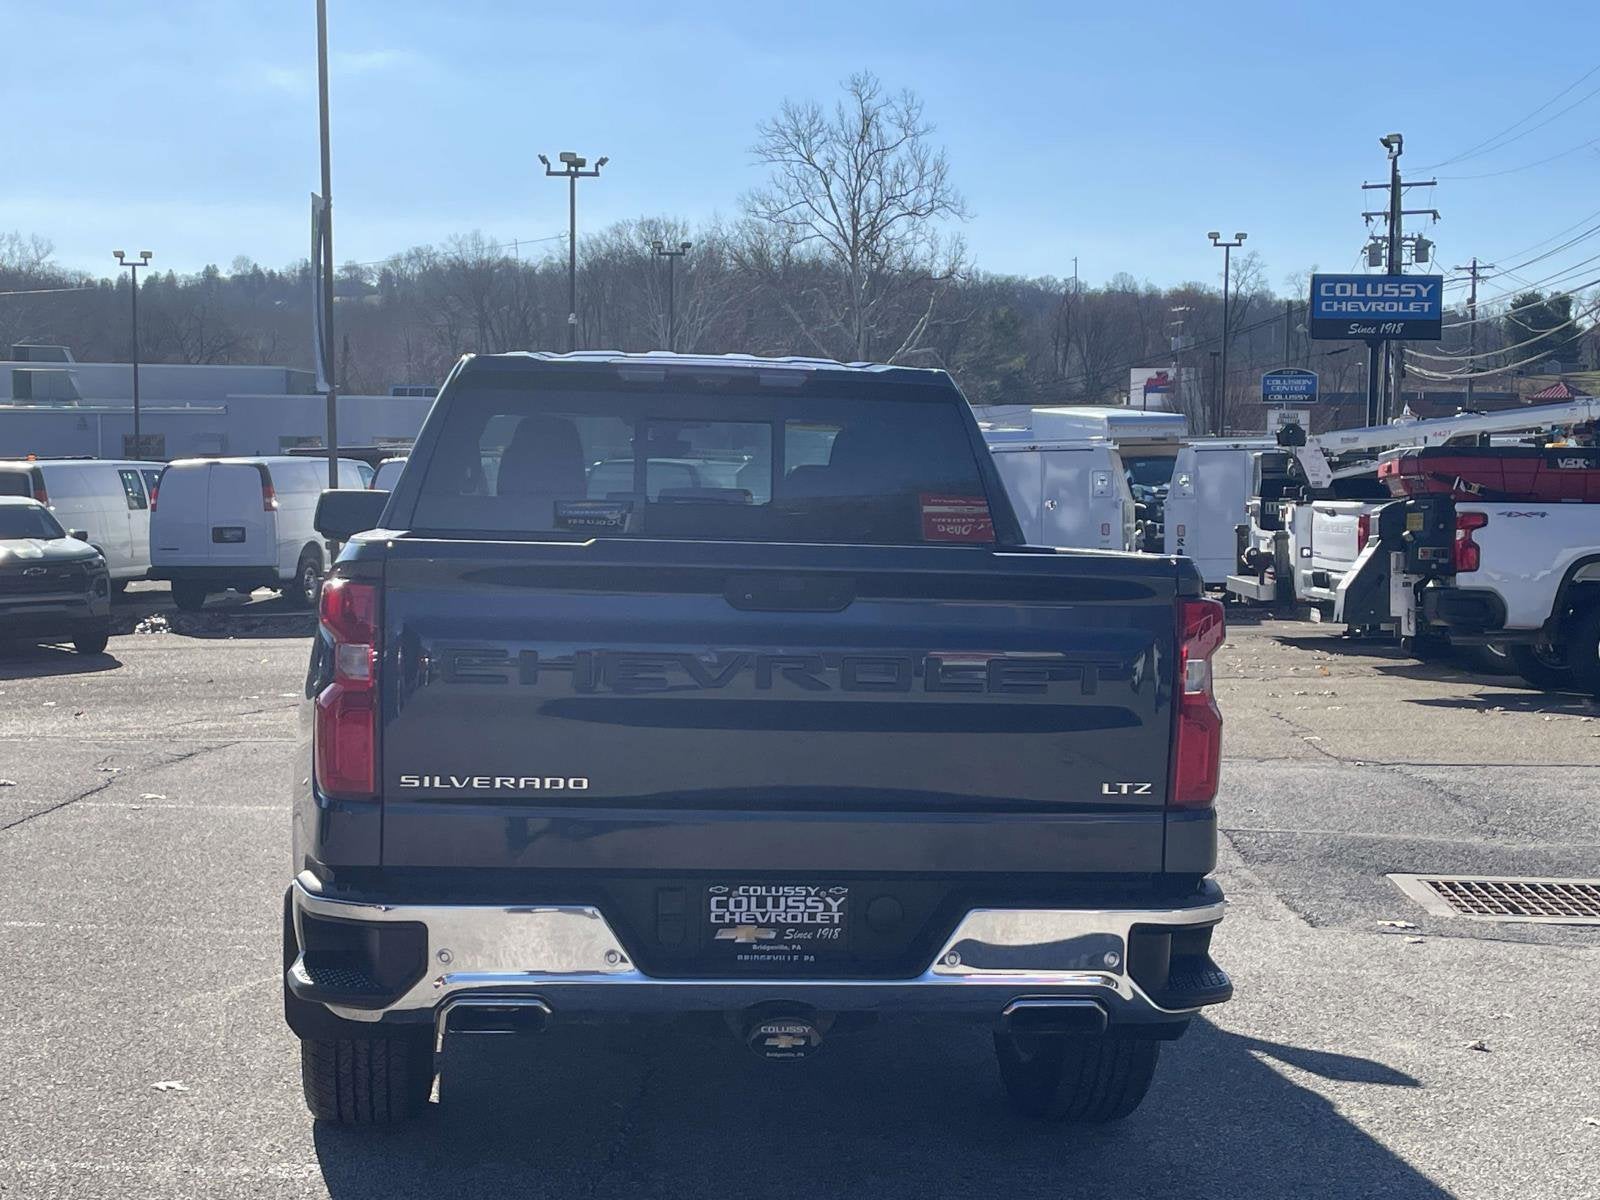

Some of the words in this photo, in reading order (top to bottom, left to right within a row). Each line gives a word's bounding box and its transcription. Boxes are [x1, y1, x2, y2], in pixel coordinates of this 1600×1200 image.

[1320, 282, 1434, 298] COLUSSY
[1321, 301, 1433, 313] CHEVROLET
[1347, 323, 1377, 335] Since
[1379, 322, 1405, 335] 1918
[441, 648, 1123, 695] CHEVROLET
[399, 775, 590, 790] SILVERADO
[1101, 782, 1152, 795] LTZ
[738, 885, 821, 896] COLUSSY
[710, 896, 846, 913] COLUSSY
[710, 911, 844, 924] CHEVROLET
[783, 928, 813, 940] Since
[816, 927, 842, 940] 1918
[760, 1025, 812, 1034] COLUSSY
